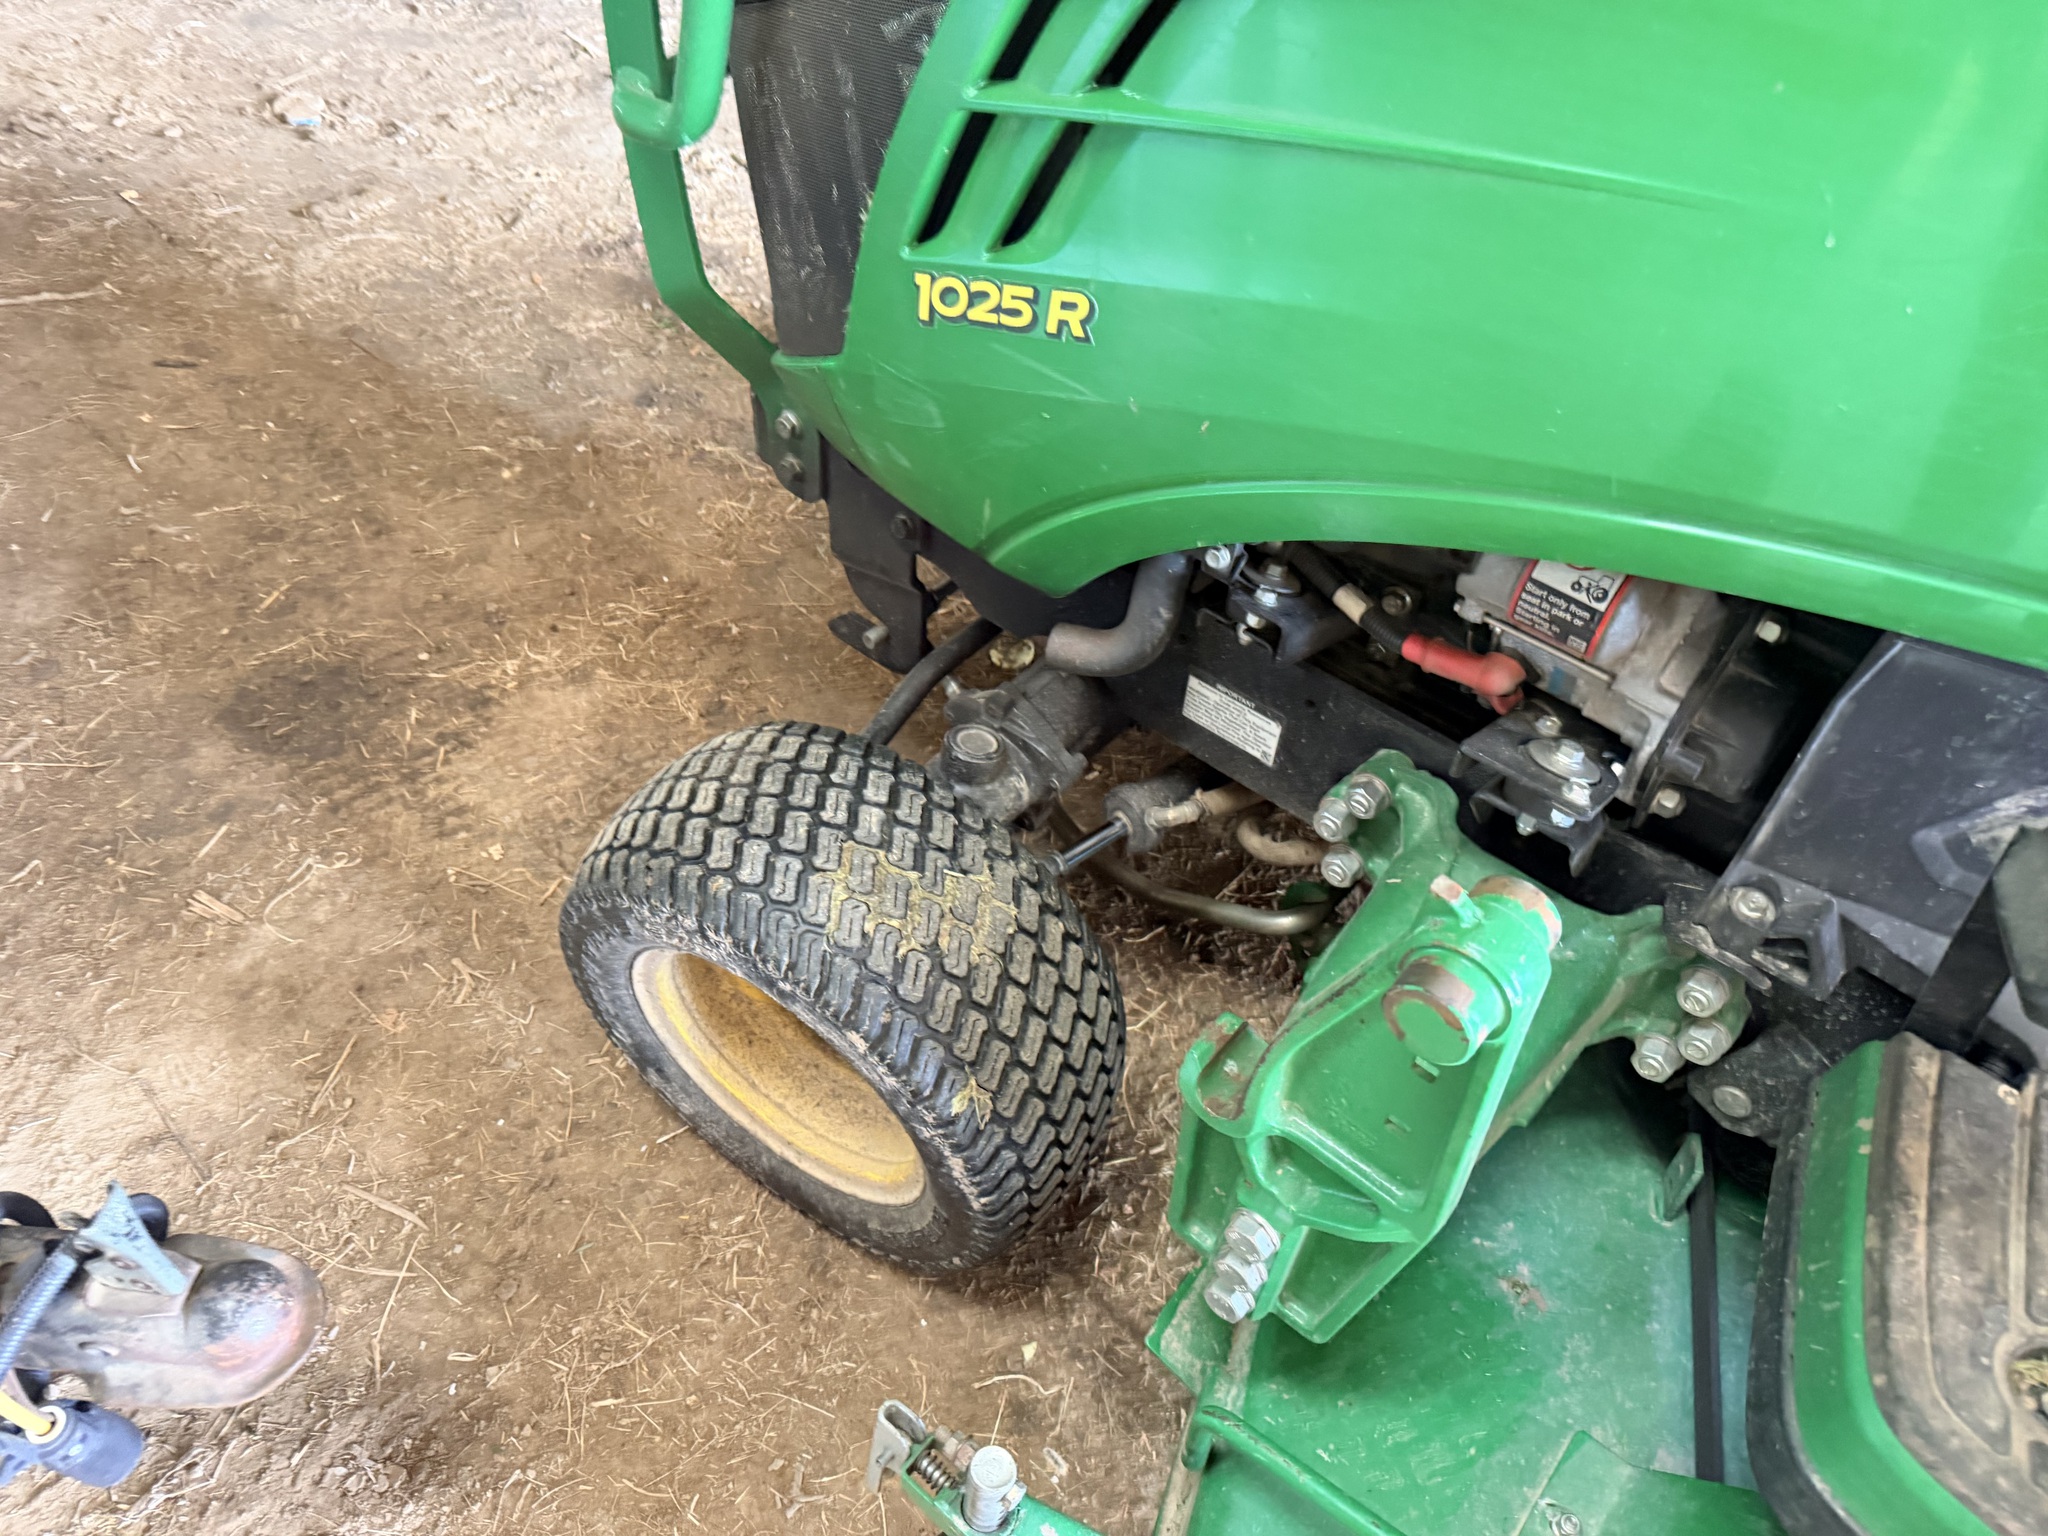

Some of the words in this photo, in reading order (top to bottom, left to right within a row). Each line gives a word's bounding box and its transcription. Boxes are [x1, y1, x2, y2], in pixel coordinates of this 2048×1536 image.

[913, 271, 1040, 332] 1025
[1045, 288, 1097, 343] R
[1521, 591, 1541, 606] seat
[1541, 601, 1550, 612] in
[1551, 607, 1572, 622] park
[1573, 619, 1585, 628] or
[1525, 582, 1548, 599] Start
[1548, 594, 1568, 610] only
[1569, 604, 1591, 620] from
